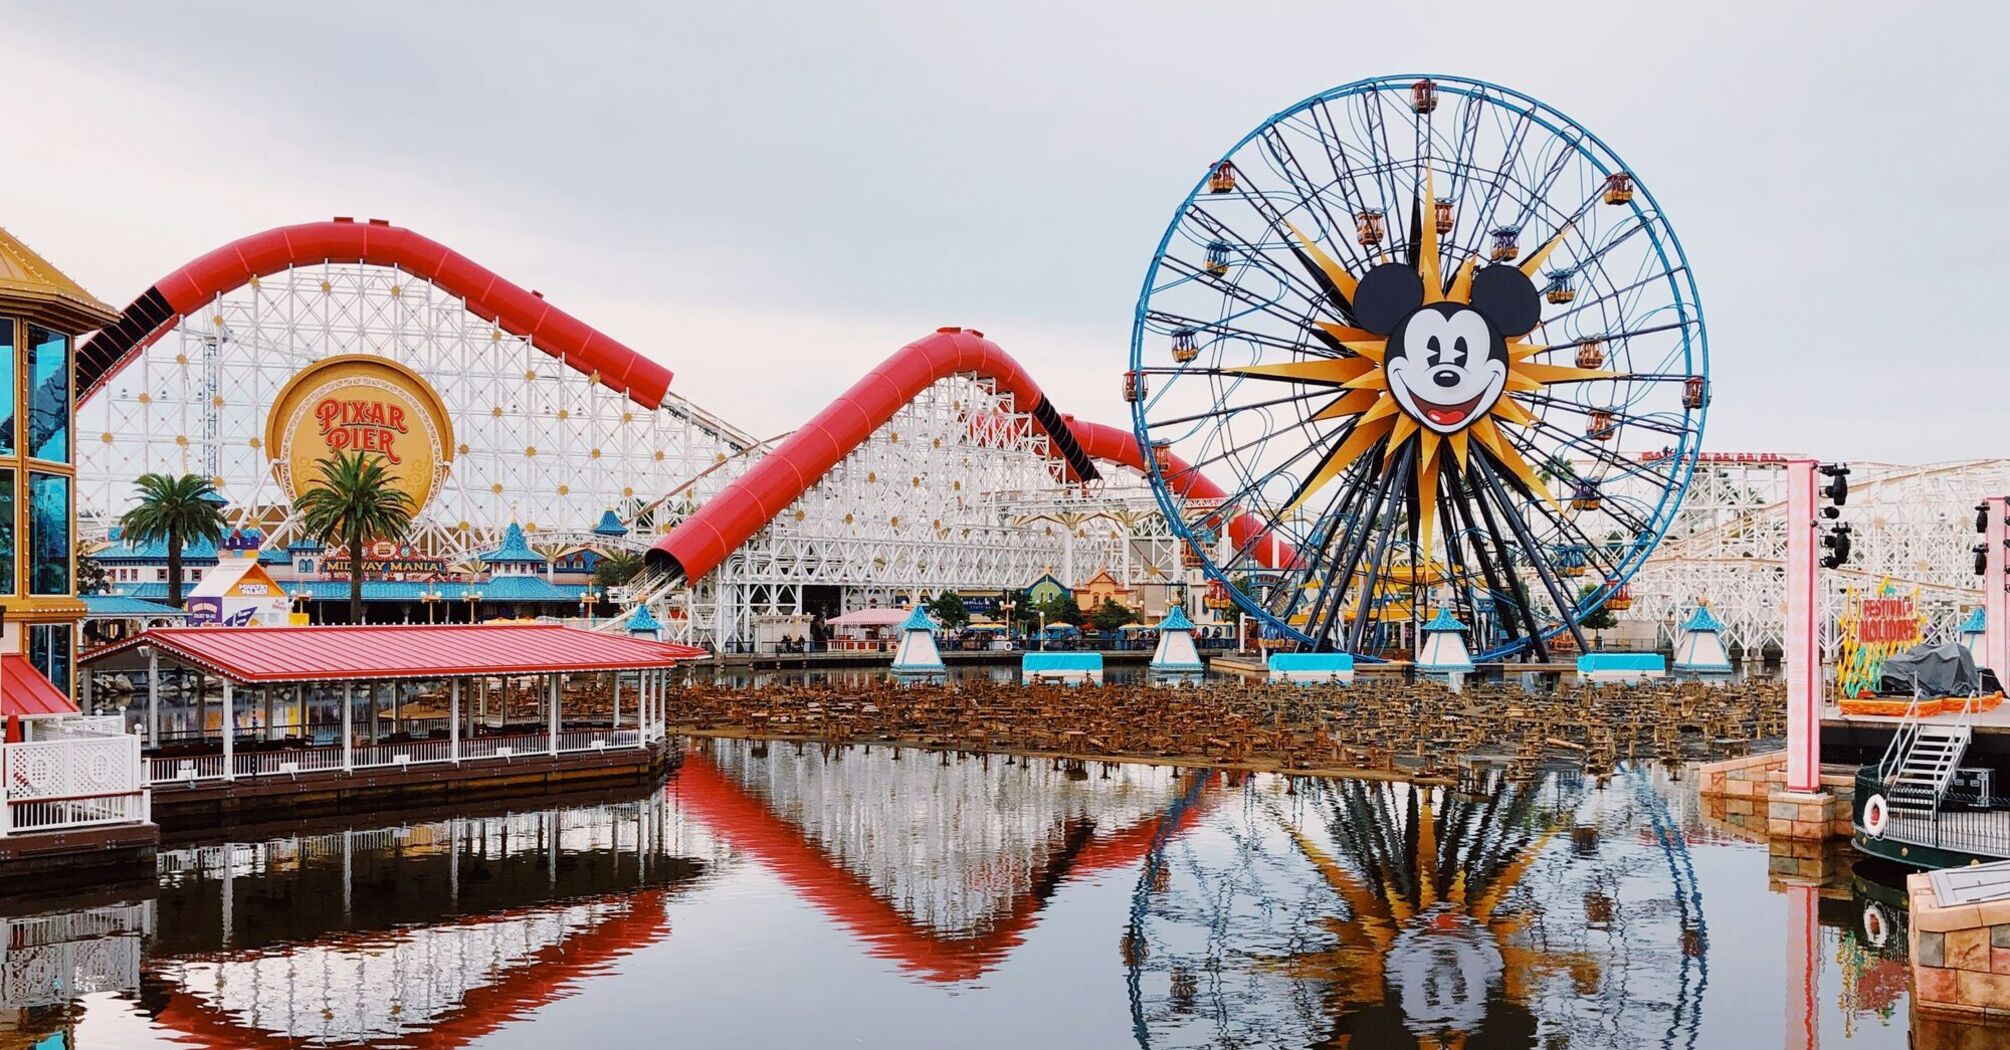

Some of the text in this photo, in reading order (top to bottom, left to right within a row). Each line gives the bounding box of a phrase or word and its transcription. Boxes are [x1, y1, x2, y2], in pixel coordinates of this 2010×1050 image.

[315, 399, 409, 434] PIXAR
[326, 427, 402, 464] PIER
[1860, 619, 1918, 642] HOLIDAYS
